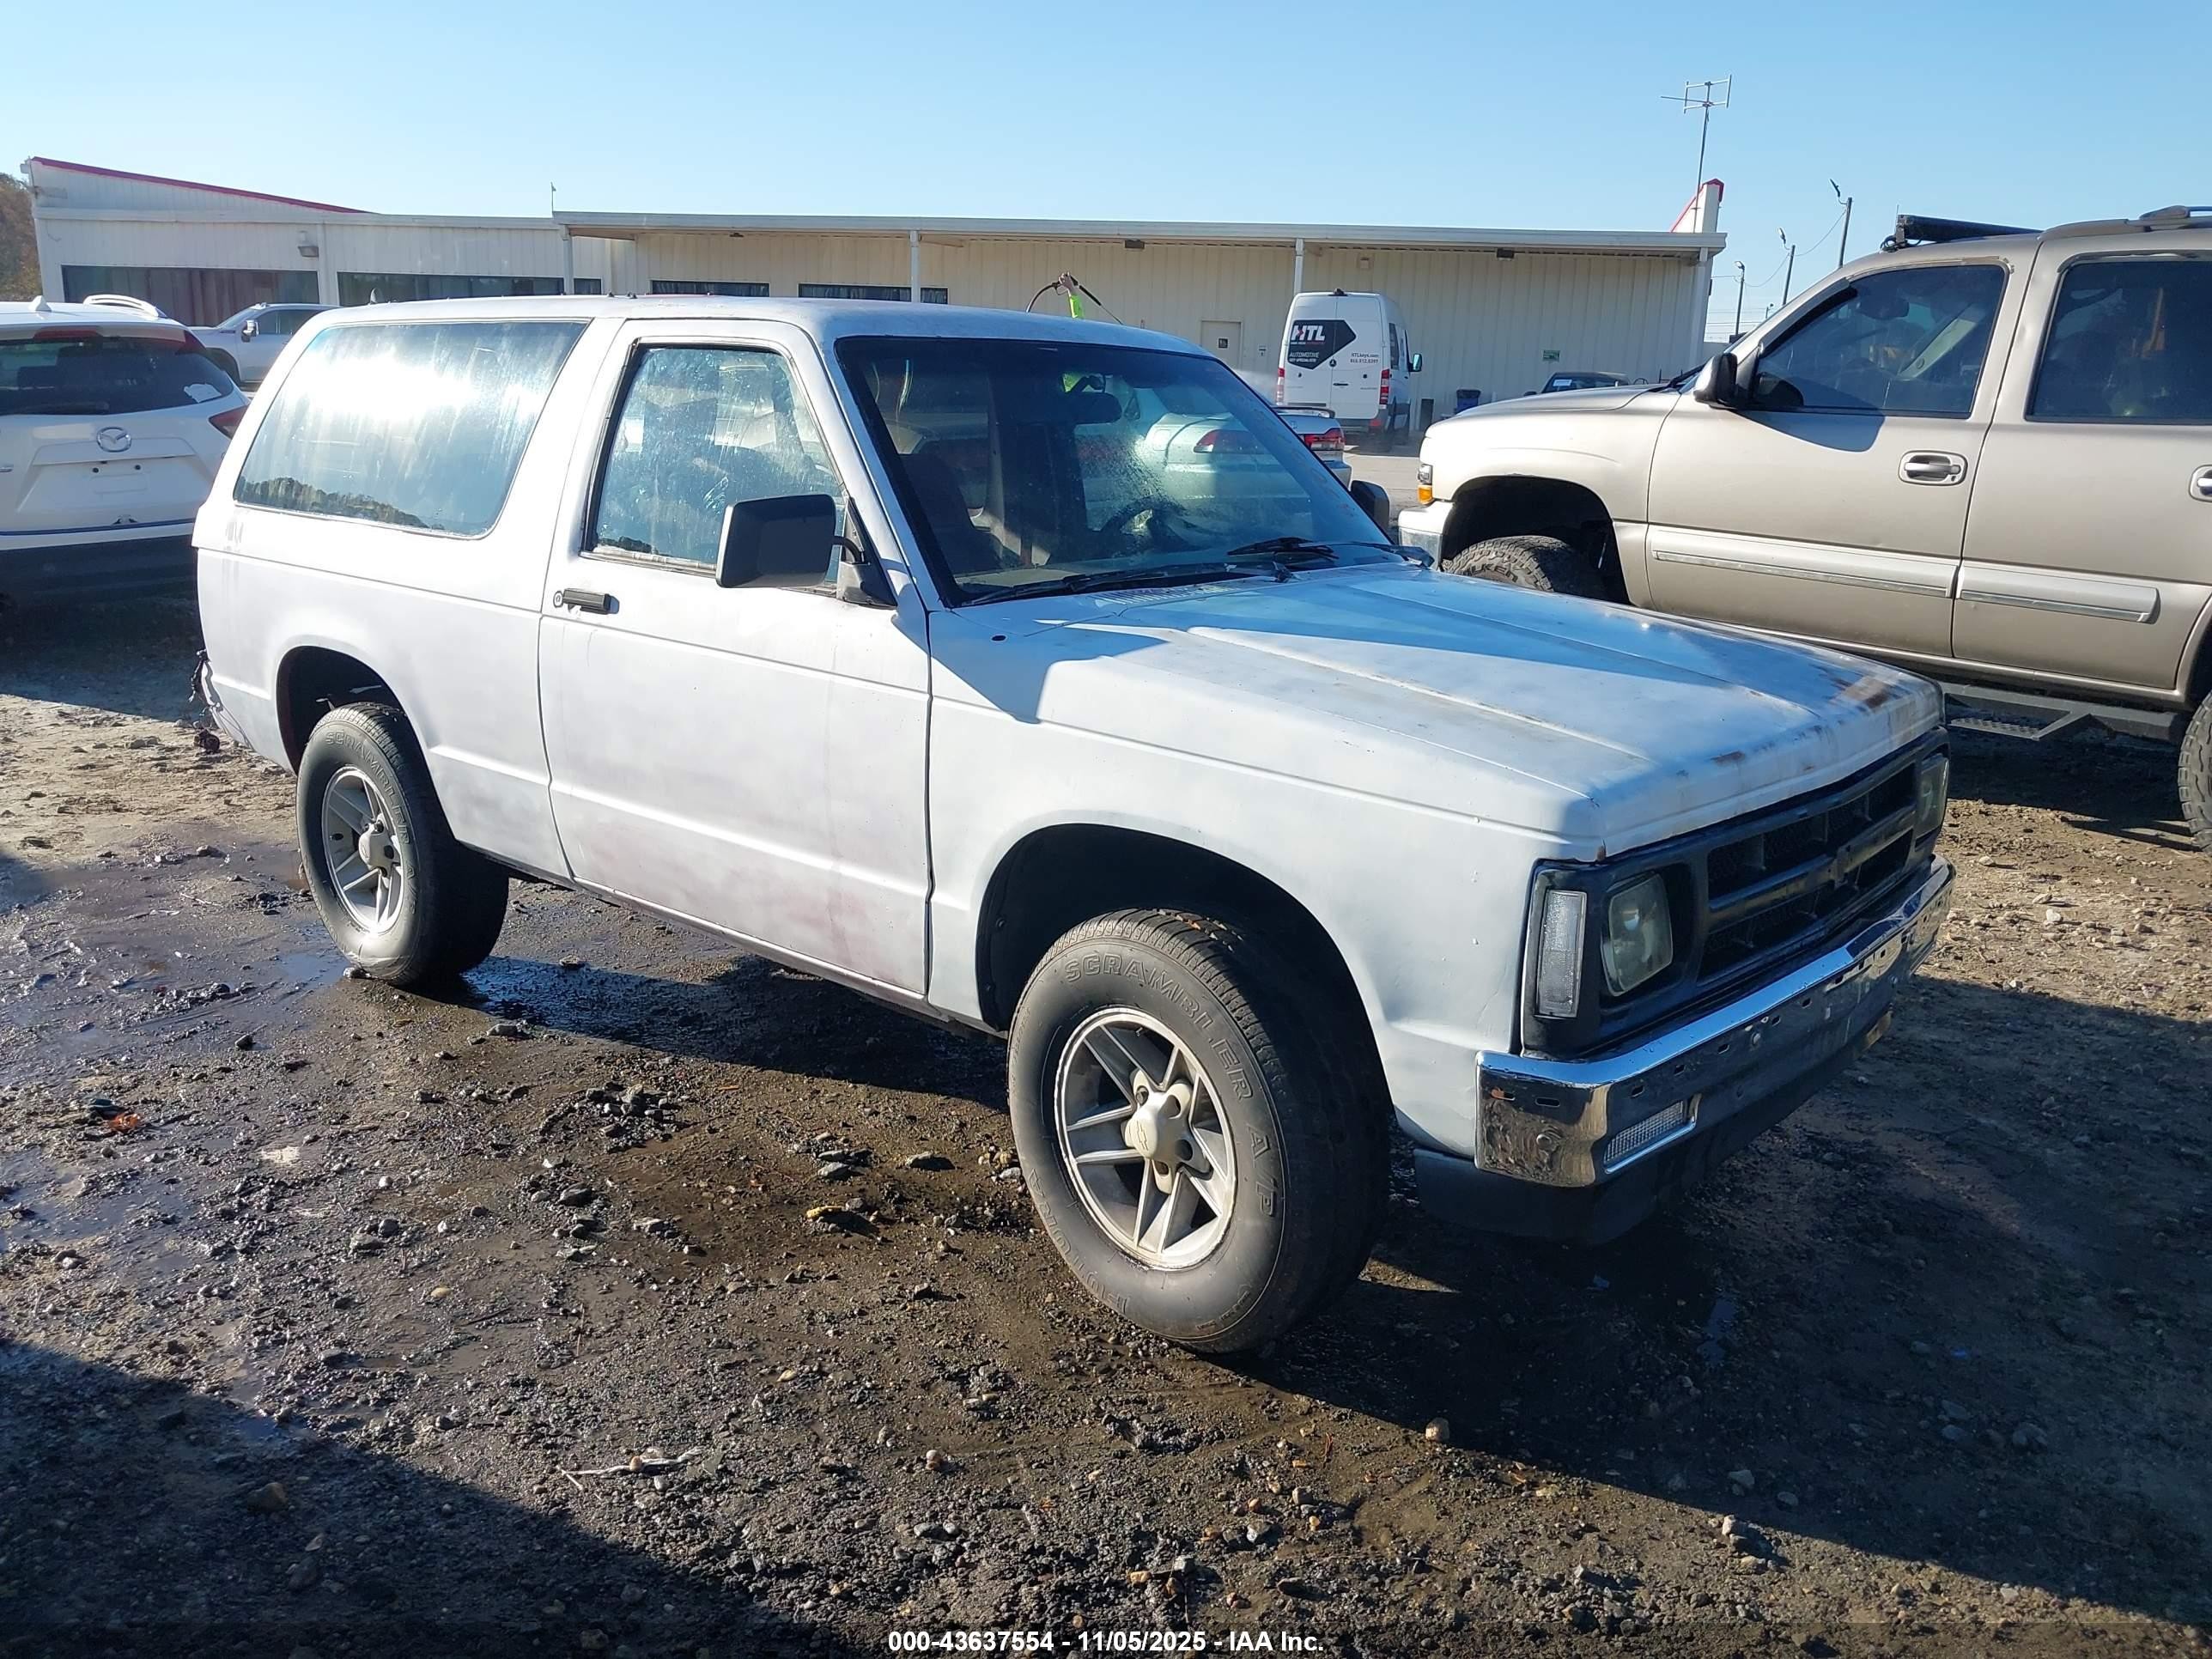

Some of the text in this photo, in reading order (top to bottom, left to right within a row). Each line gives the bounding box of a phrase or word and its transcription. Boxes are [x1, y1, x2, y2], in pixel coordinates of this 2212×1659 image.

[1291, 325, 1326, 341] HTL
[1065, 952, 1279, 1217] SCRAMBLER A/P
[1030, 1168, 1131, 1315] FUTURA
